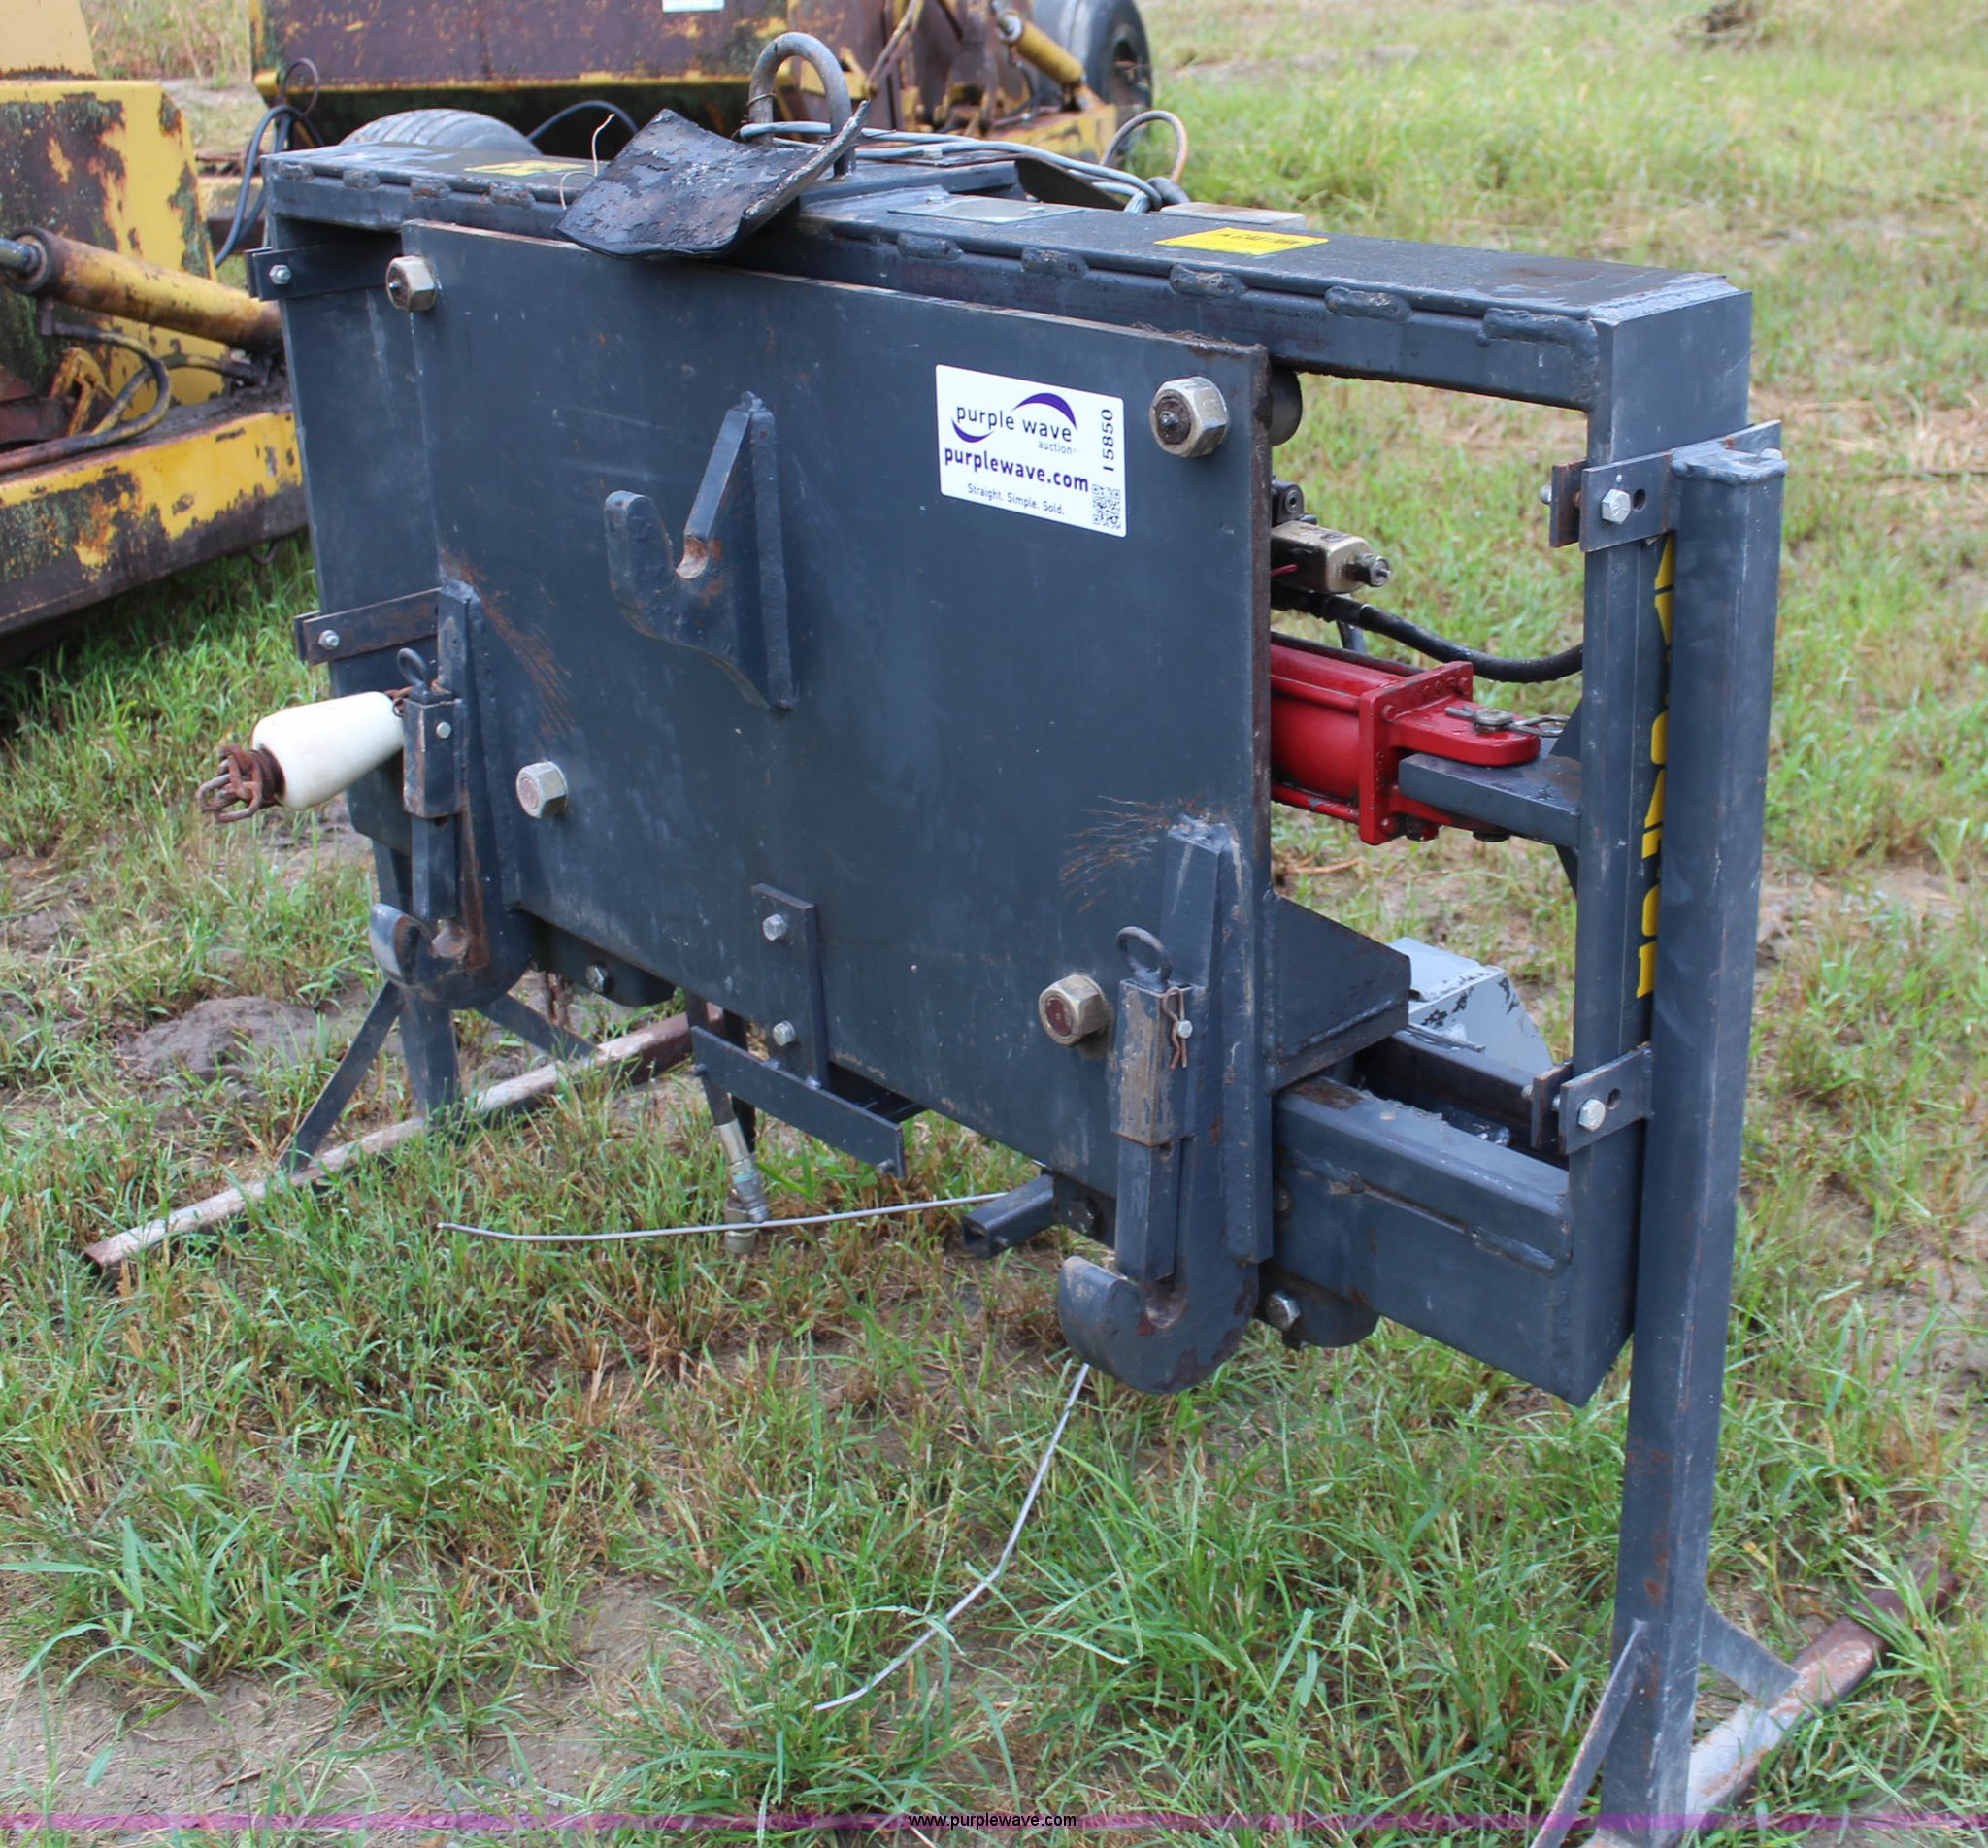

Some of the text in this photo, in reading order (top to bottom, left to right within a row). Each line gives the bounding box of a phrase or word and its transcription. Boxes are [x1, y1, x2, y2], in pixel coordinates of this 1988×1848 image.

[956, 406, 1072, 442] purple wave
[1038, 441, 1072, 455] auction
[944, 447, 1089, 492] purplewave.com
[967, 483, 1065, 515] Straight. Simple. Sold.
